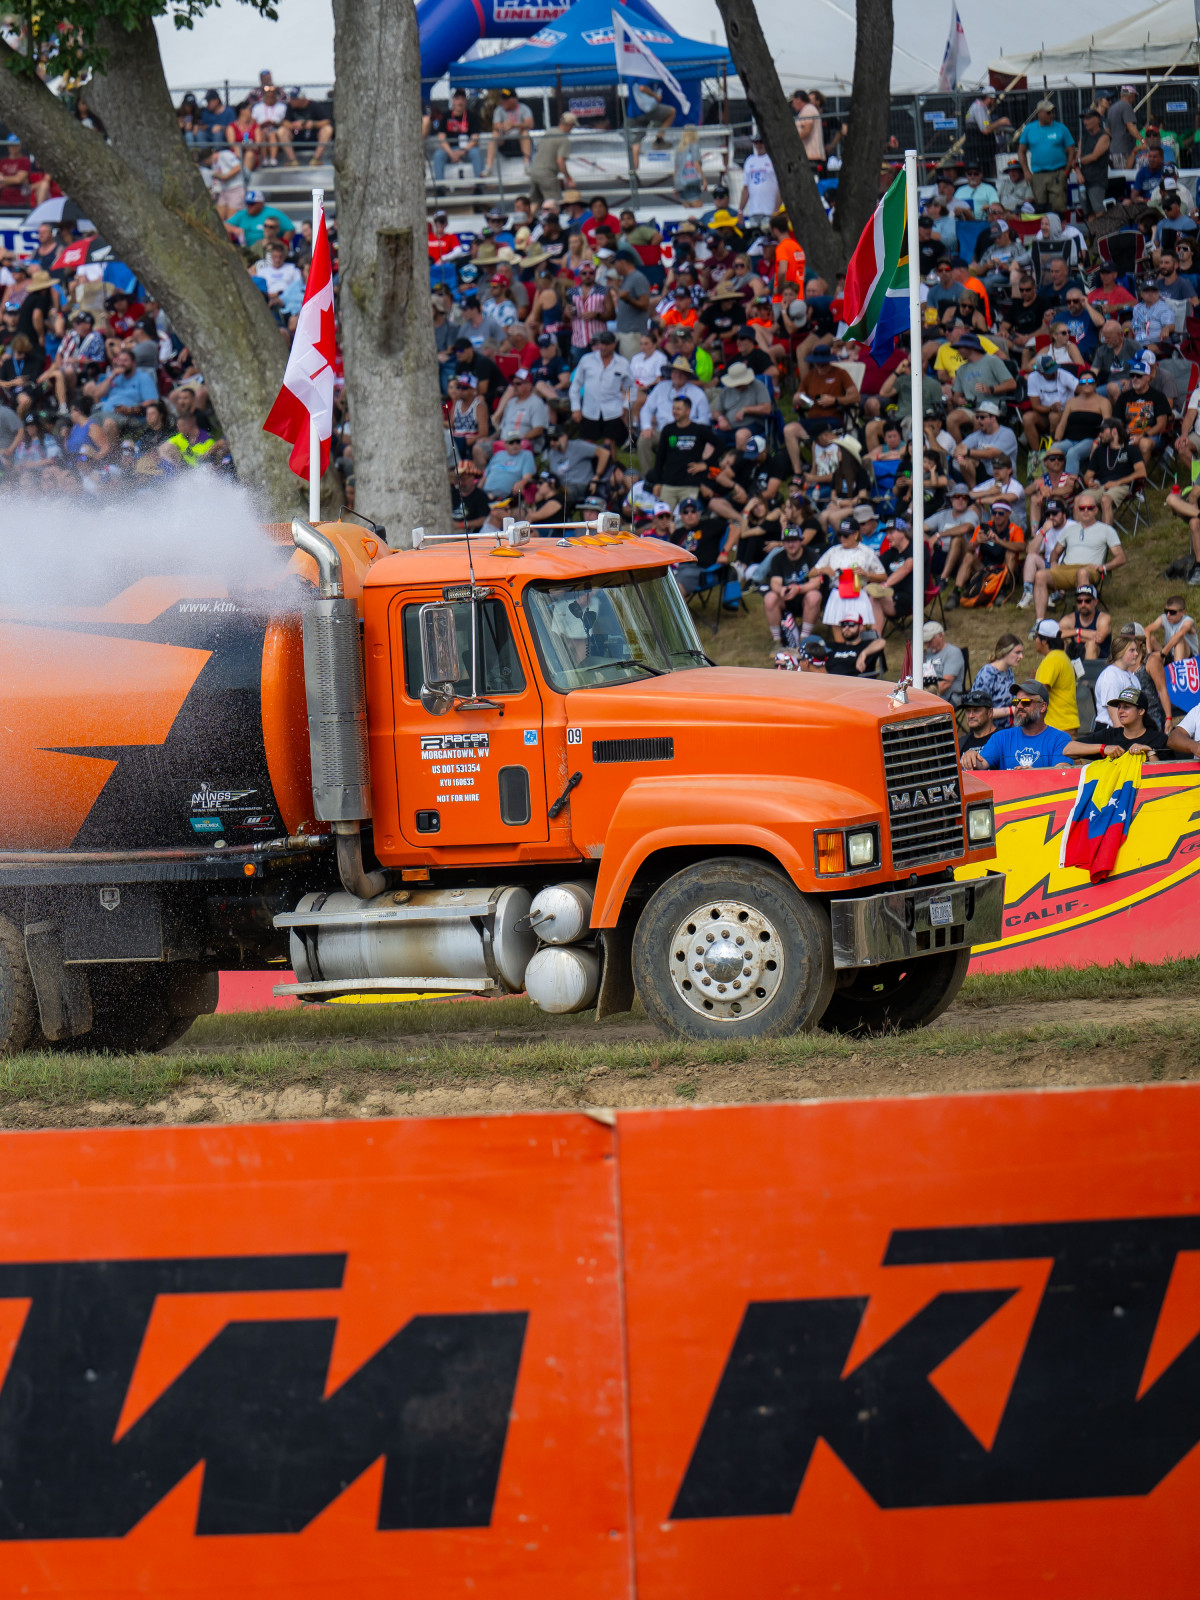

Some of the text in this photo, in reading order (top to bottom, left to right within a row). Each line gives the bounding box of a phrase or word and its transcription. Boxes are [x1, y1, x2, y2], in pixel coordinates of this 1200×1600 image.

[496, 8, 567, 20] UNLIM
[179, 601, 250, 612] www.ktm.
[567, 729, 582, 743] 09
[421, 748, 490, 760] MORGANTOWN, WV
[432, 763, 481, 774] US DOT 531354
[436, 793, 480, 803] NOT FOR HIRE
[890, 783, 959, 811] MACK
[1005, 900, 1089, 928] CALIF.
[668, 1214, 1200, 1521] KT
